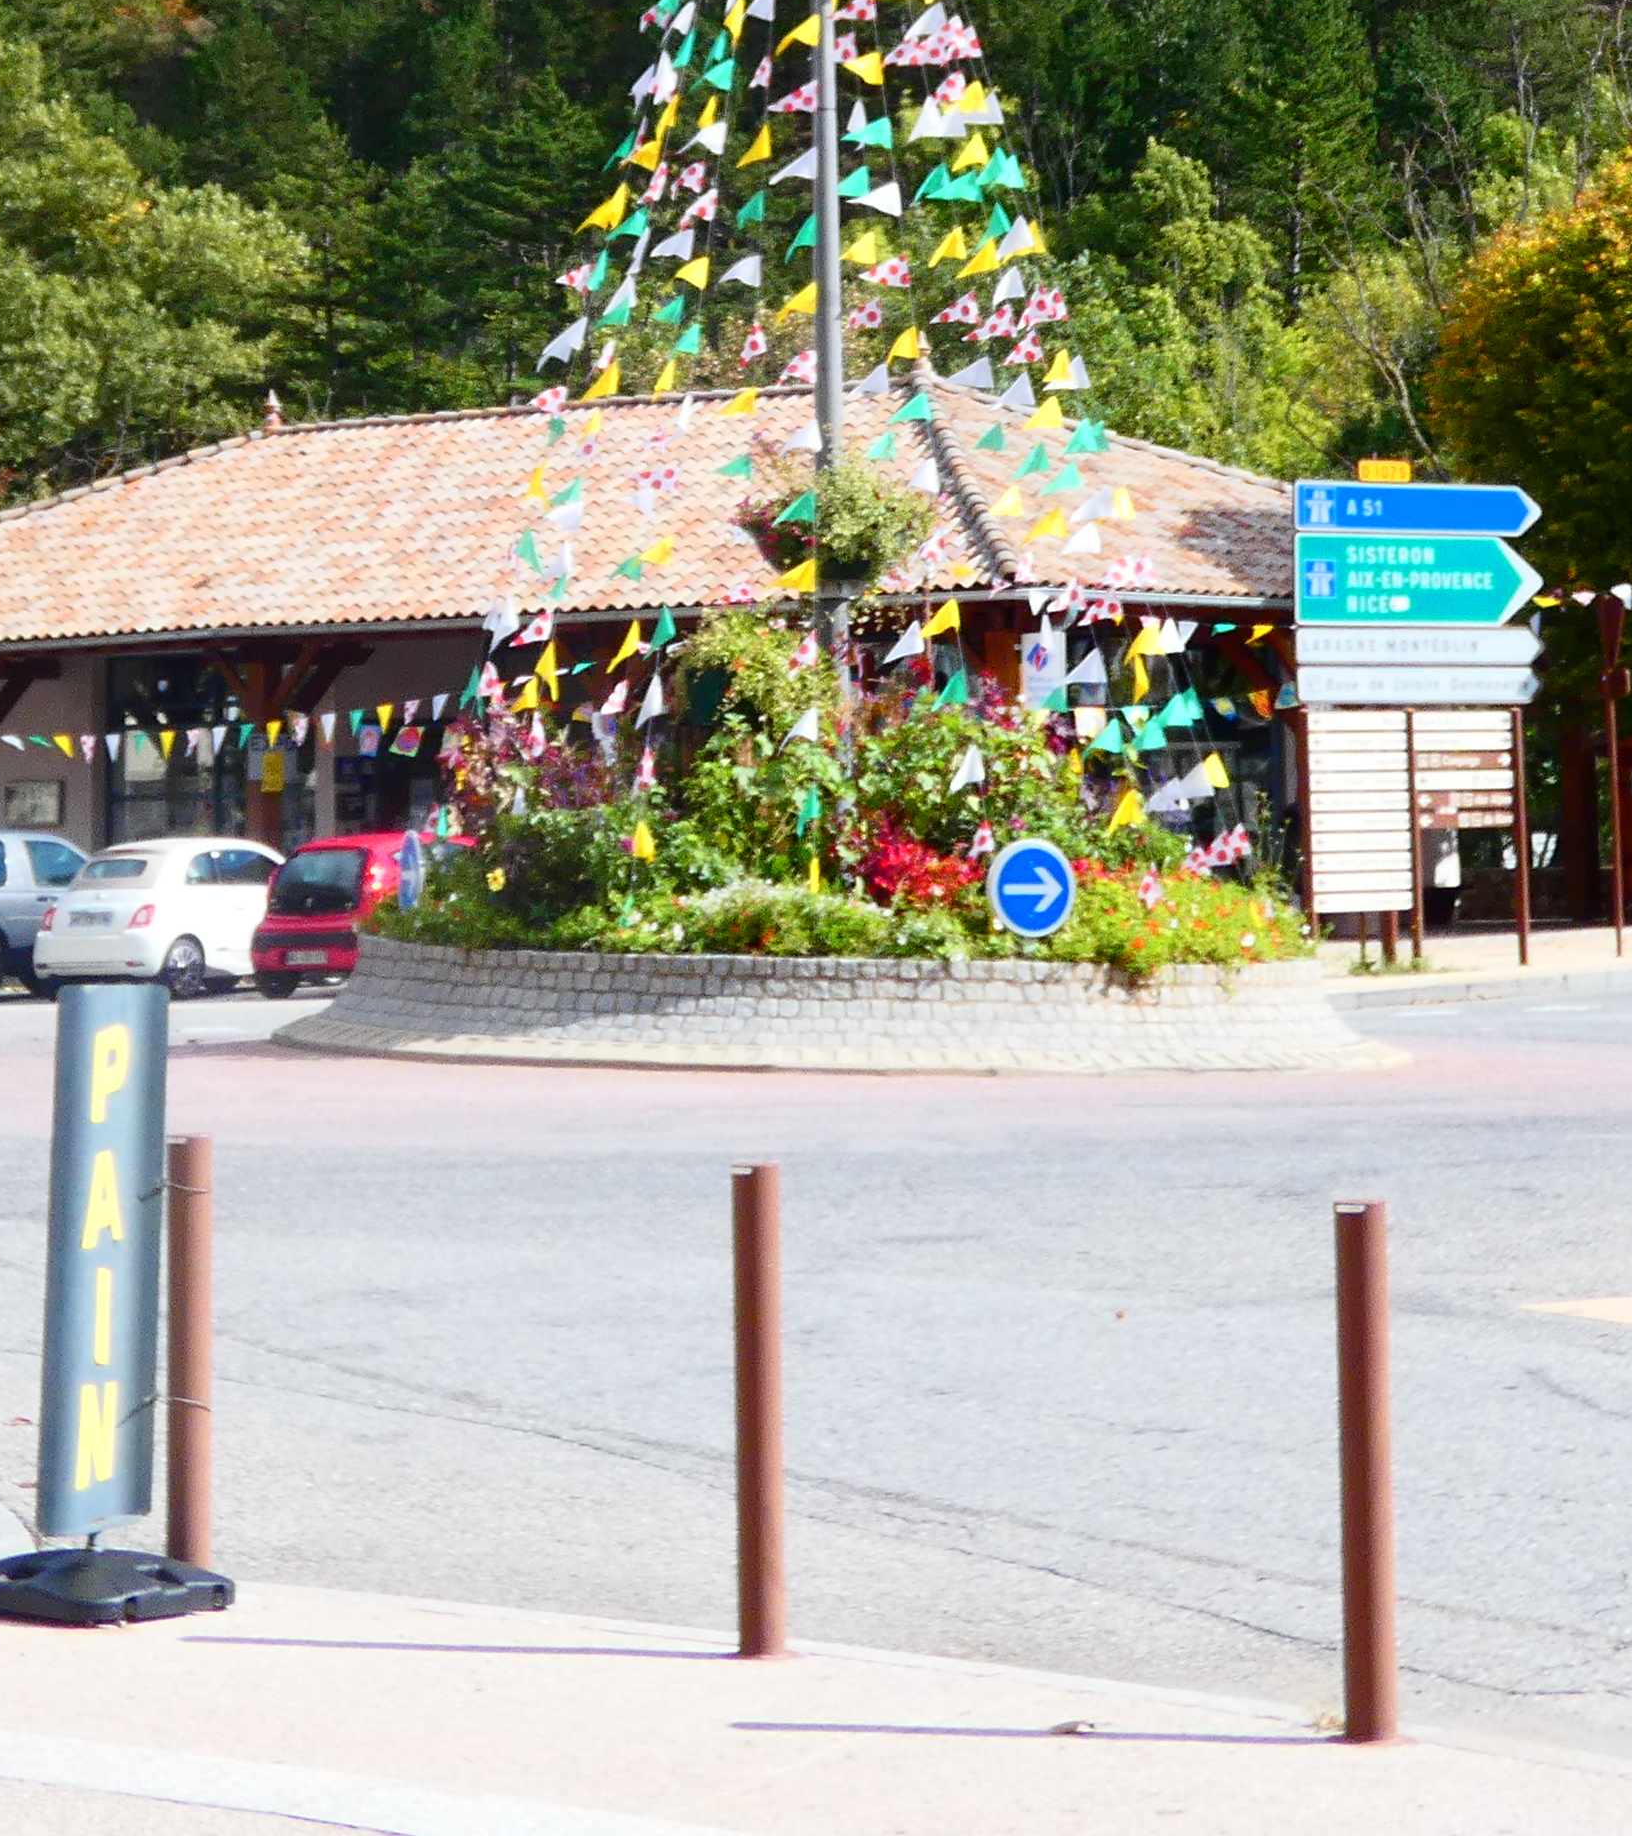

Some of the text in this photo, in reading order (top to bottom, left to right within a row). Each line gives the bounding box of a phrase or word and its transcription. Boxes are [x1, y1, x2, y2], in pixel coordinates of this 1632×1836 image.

[1346, 499, 1384, 517] A 51
[1345, 545, 1436, 566] SISTERON
[1346, 570, 1494, 591] AIX-EN-PROVENCE
[1346, 595, 1389, 614] NICE
[74, 1023, 130, 1491] PAIN
